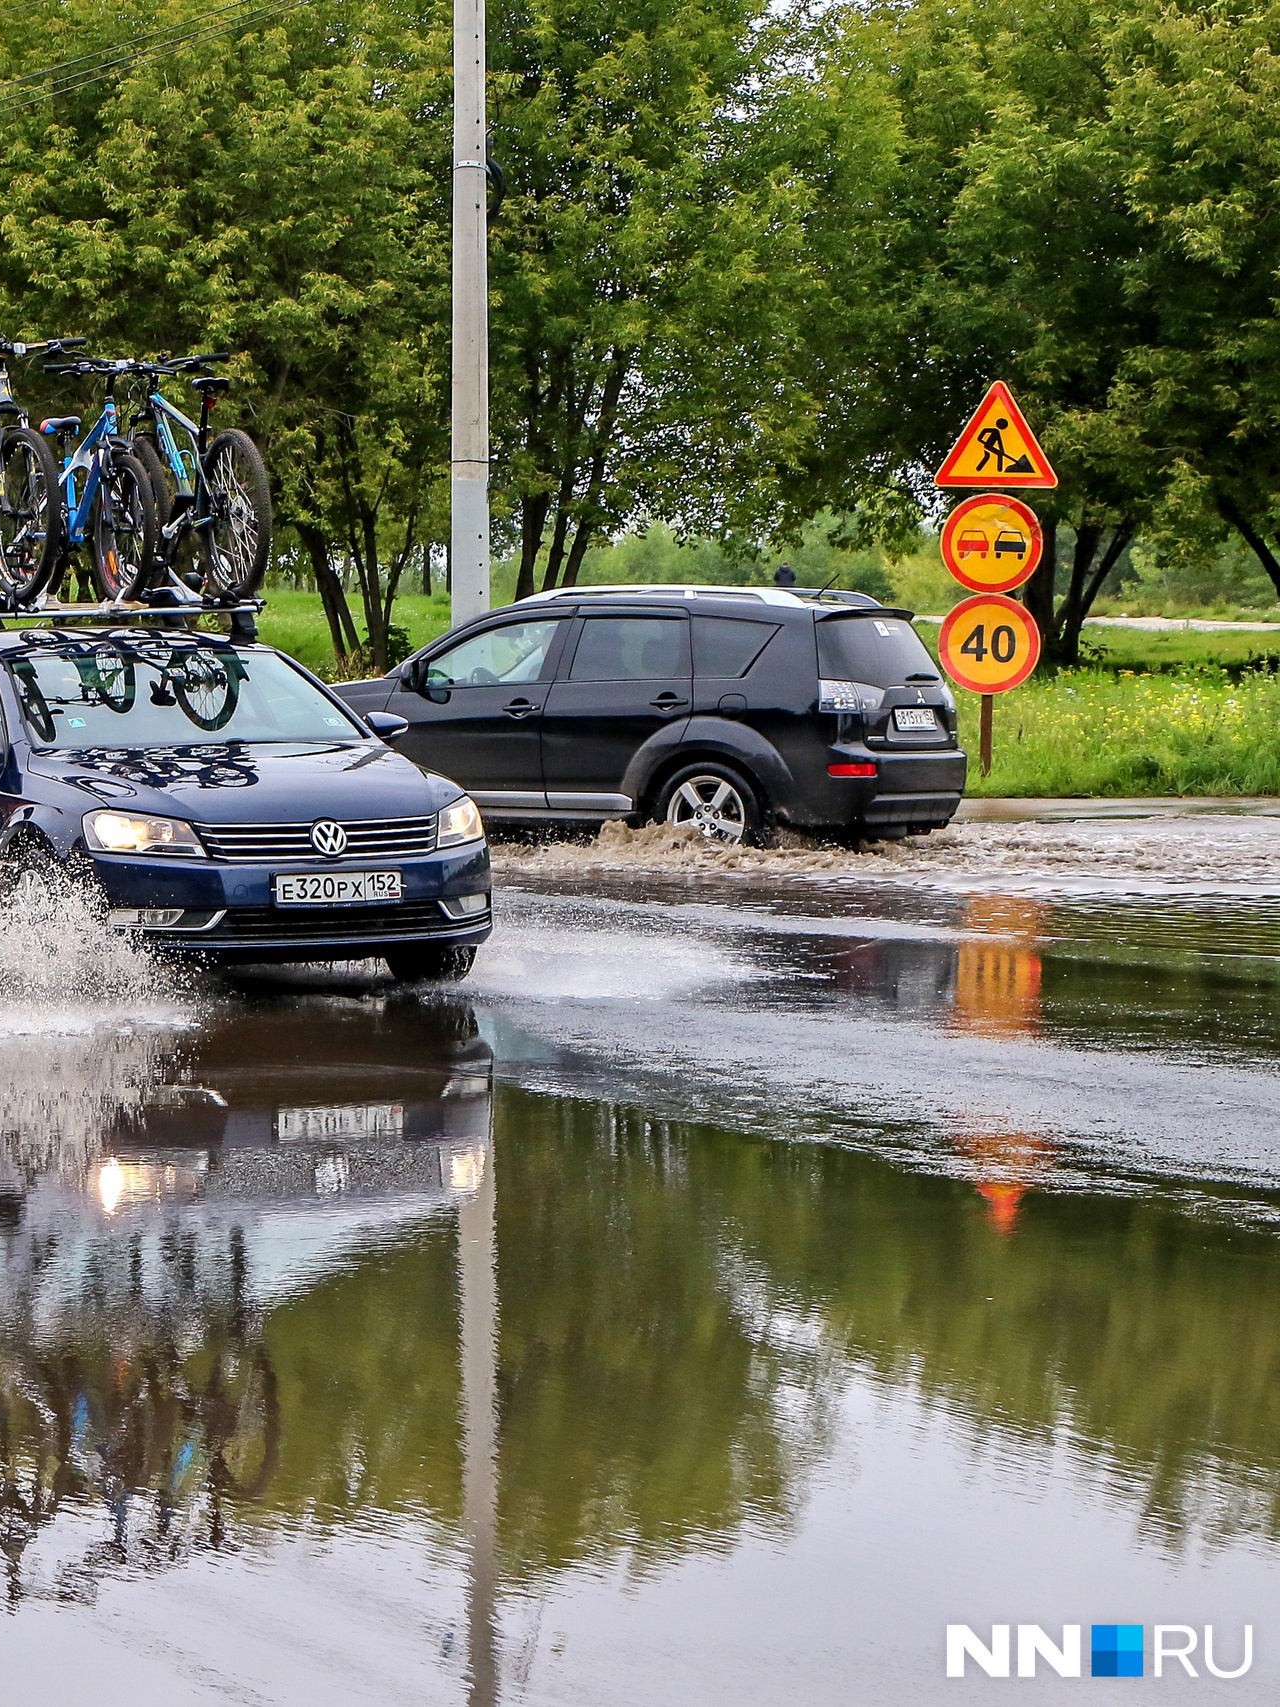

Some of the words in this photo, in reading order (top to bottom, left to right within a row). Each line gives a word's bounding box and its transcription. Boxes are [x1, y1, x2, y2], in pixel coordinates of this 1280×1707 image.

[960, 623, 1016, 663] 40
[282, 876, 363, 901] Е320РХ
[367, 874, 396, 892] 152
[373, 890, 389, 898] RUS
